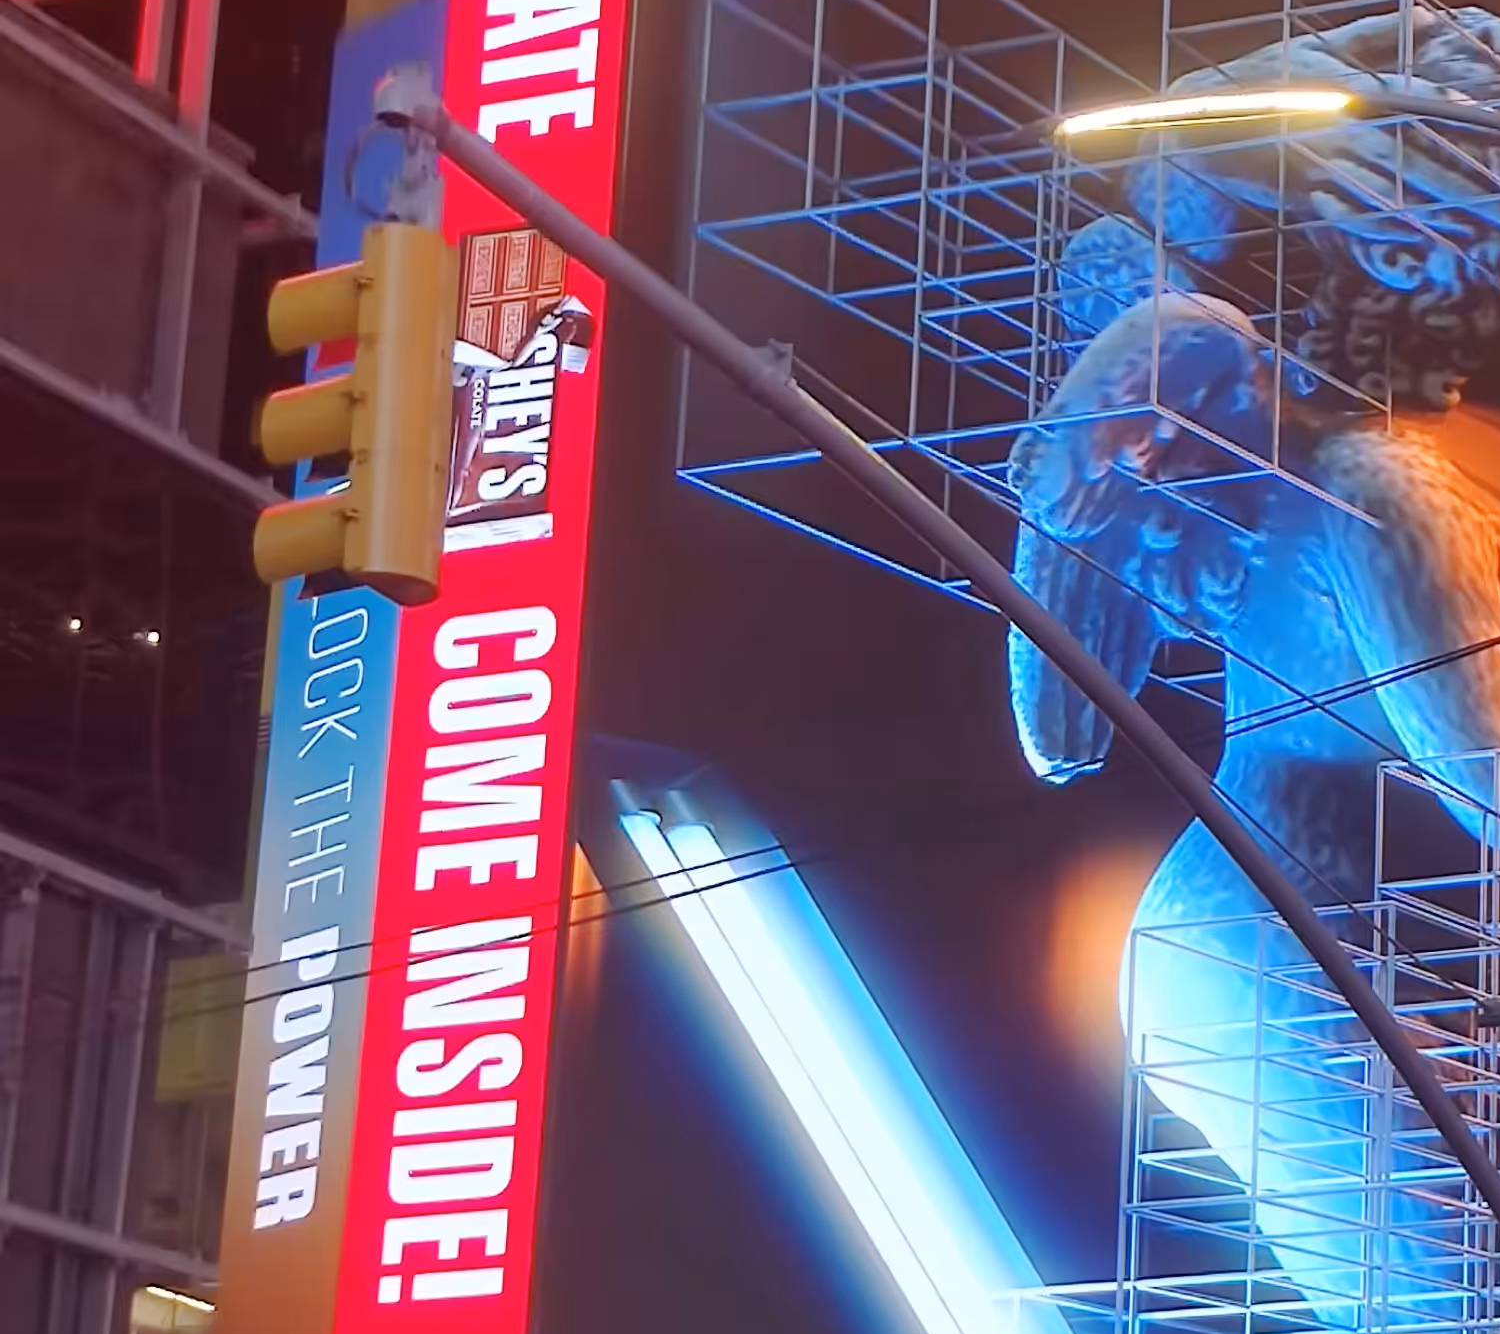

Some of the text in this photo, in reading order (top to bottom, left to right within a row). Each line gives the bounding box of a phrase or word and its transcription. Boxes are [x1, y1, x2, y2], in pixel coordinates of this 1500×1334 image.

[252, 596, 371, 1232] OCK THE POWER
[377, 605, 558, 1304] COME INSIDE!
